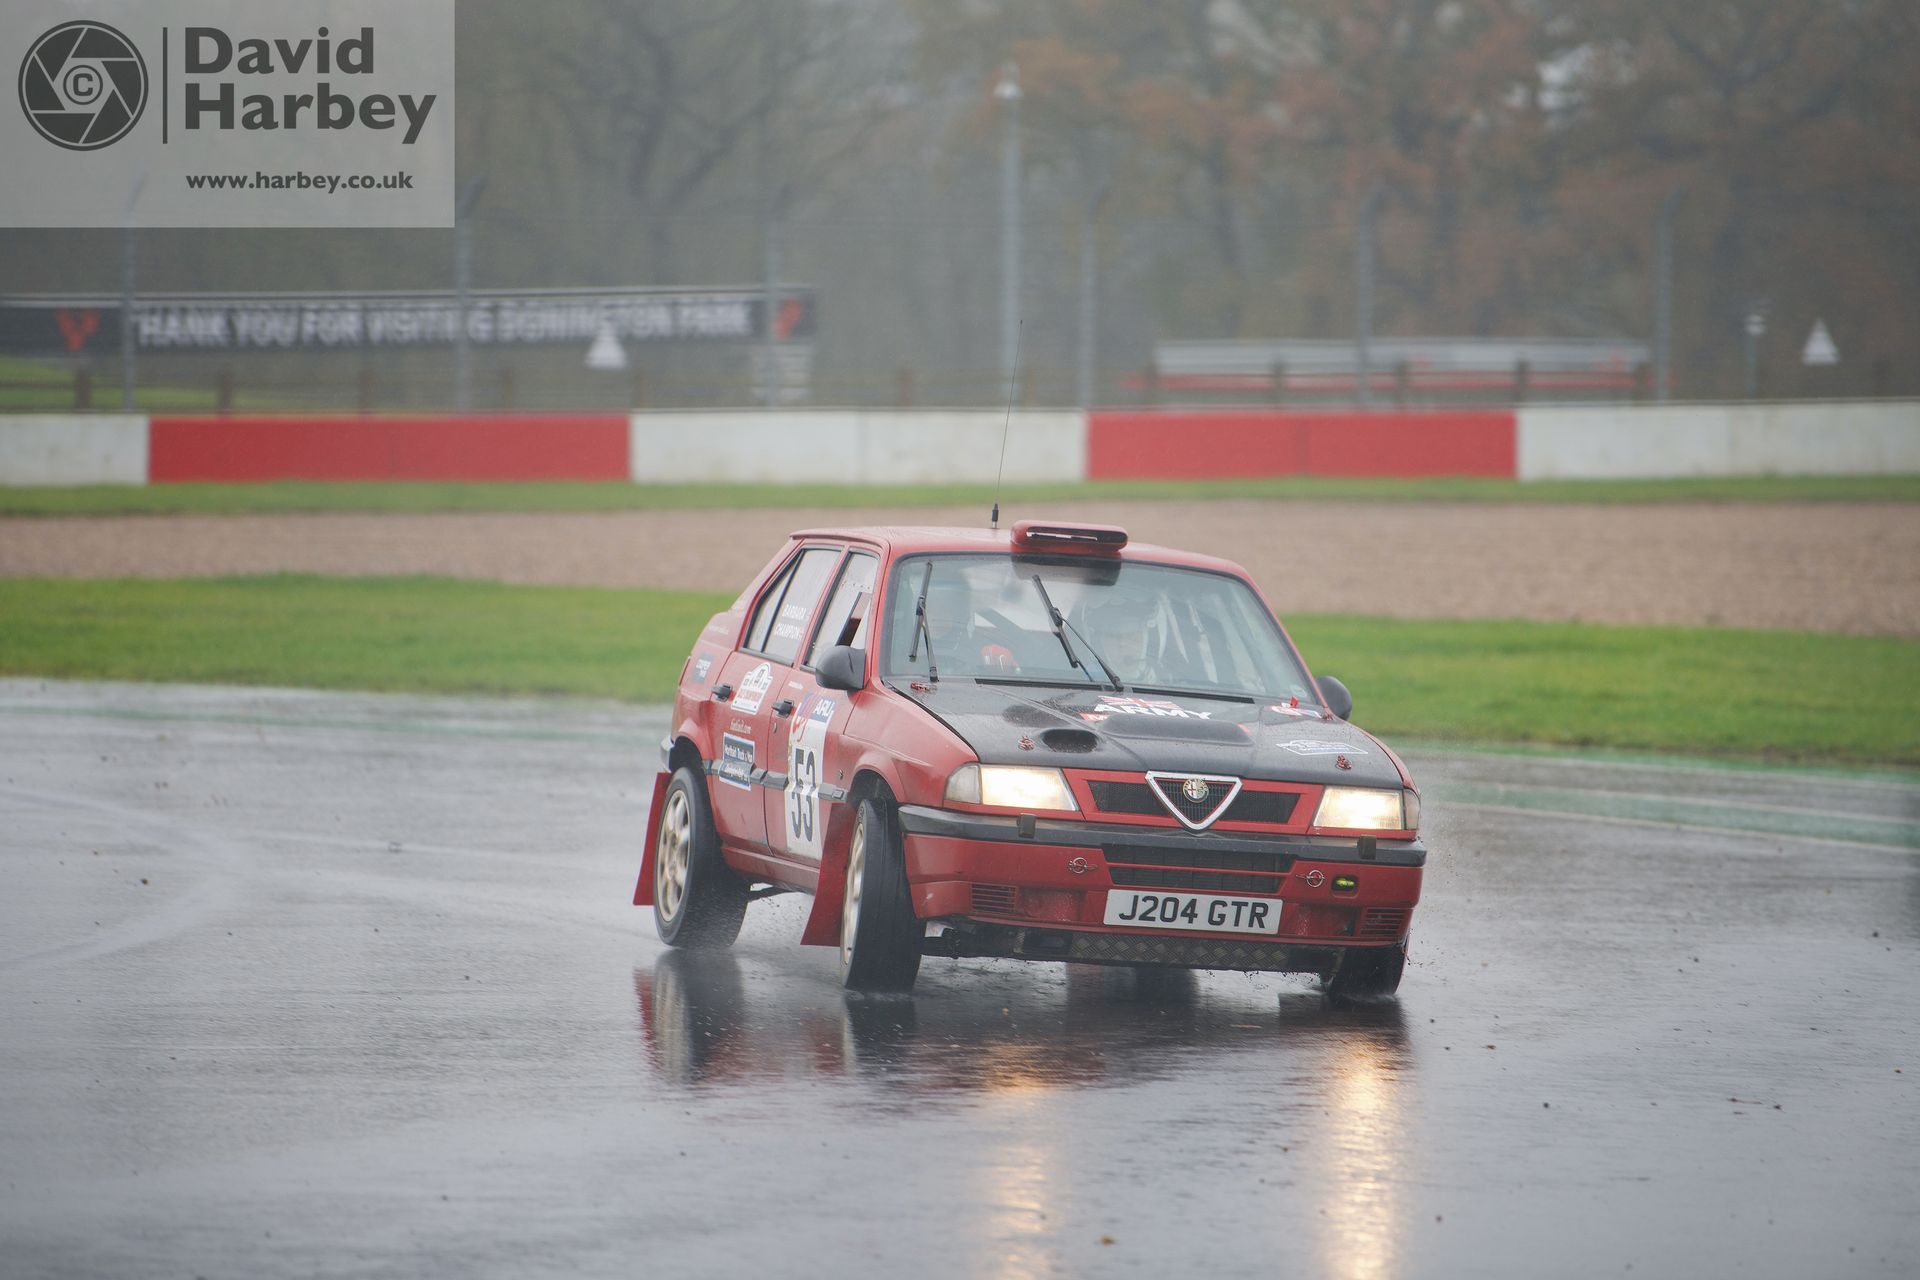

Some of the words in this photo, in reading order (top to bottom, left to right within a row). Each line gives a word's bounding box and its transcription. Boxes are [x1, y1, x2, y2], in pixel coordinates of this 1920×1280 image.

[231, 305, 299, 347] YOU
[303, 305, 363, 345] FOR
[1094, 703, 1212, 720] ARMY
[791, 747, 817, 842] 53
[1118, 894, 1199, 925] J204
[1207, 899, 1270, 930] GTR
